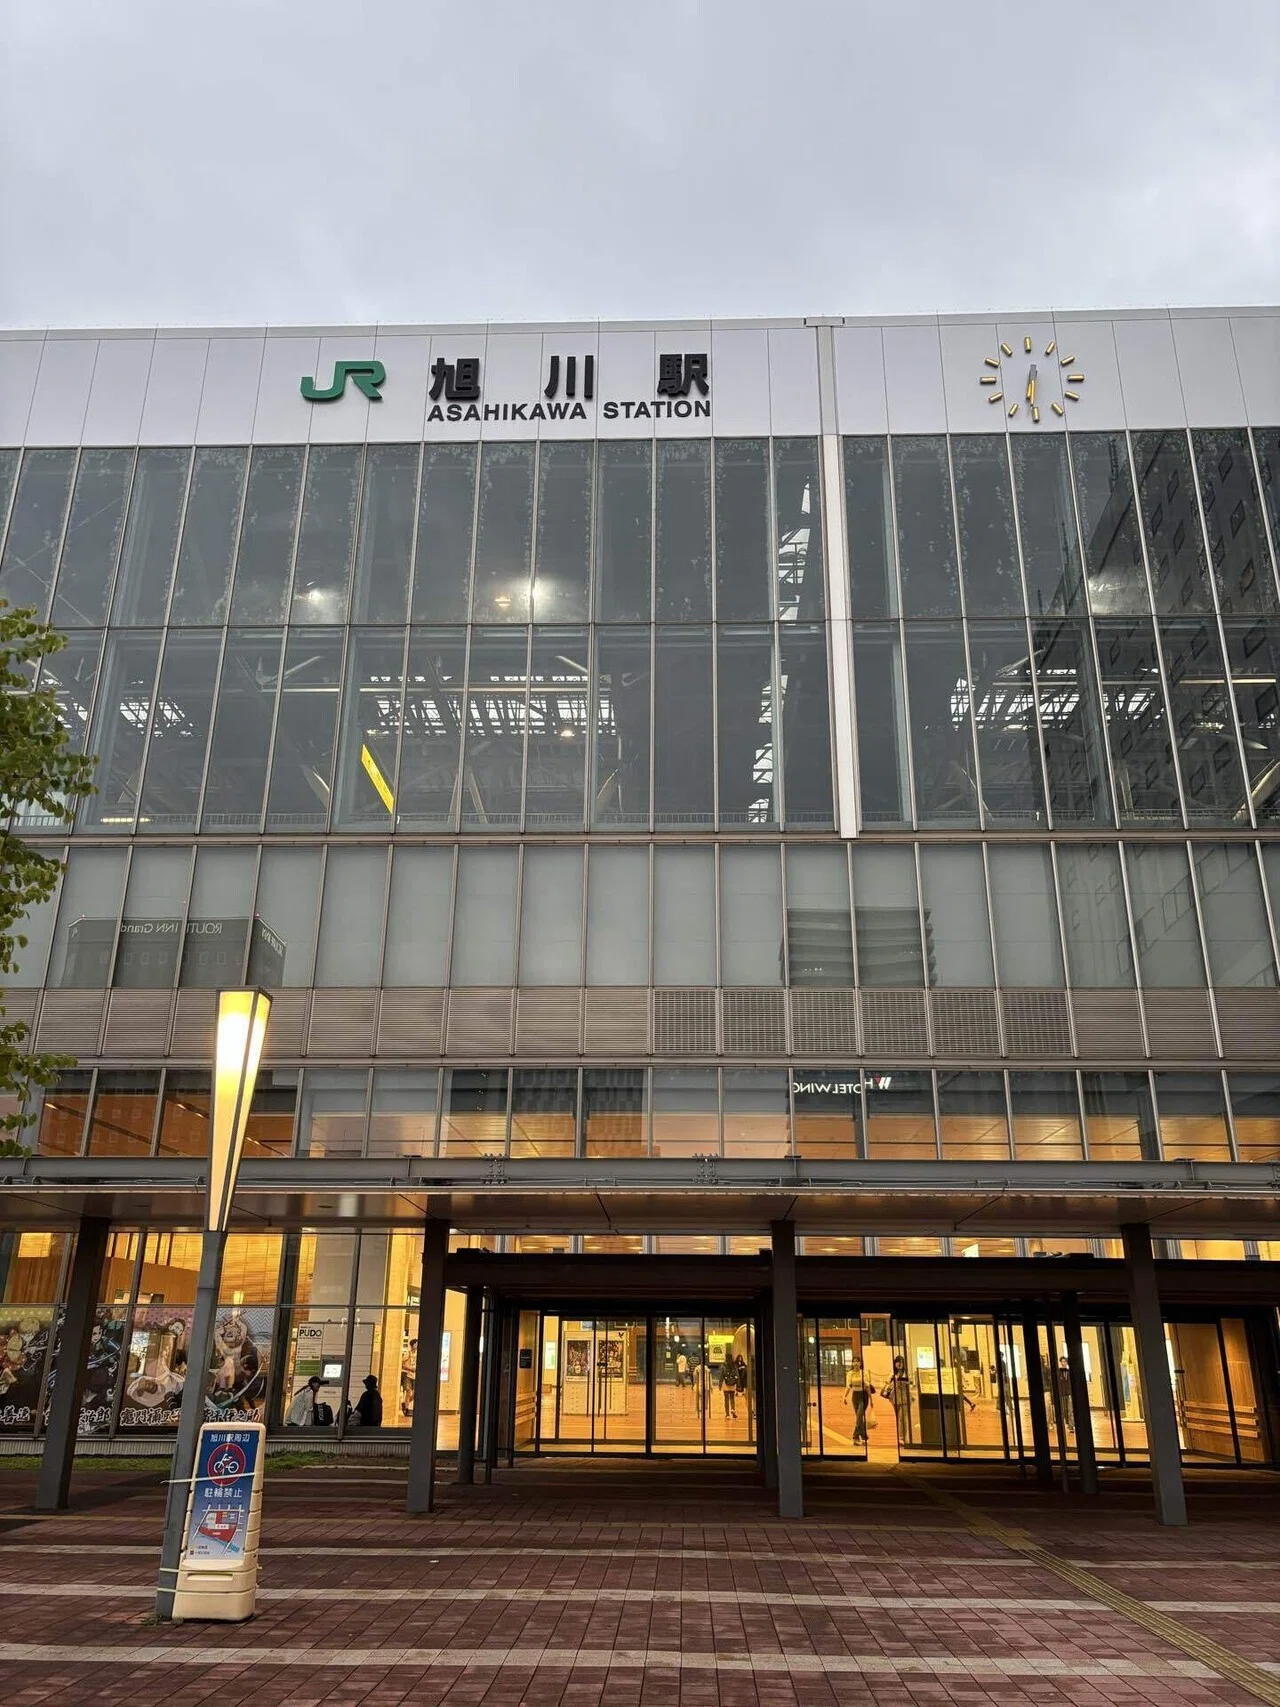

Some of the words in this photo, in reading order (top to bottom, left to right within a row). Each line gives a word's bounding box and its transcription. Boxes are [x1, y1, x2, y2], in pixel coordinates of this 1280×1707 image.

[300, 361, 386, 401] JR
[428, 354, 710, 401] 旭川駅
[427, 402, 587, 422] ASAHIKAWA
[603, 400, 711, 419] STATION
[299, 1329, 322, 1337] PUDO
[210, 1433, 250, 1443] 旭川駅周辺
[204, 1487, 243, 1498] 駐輪禁止
